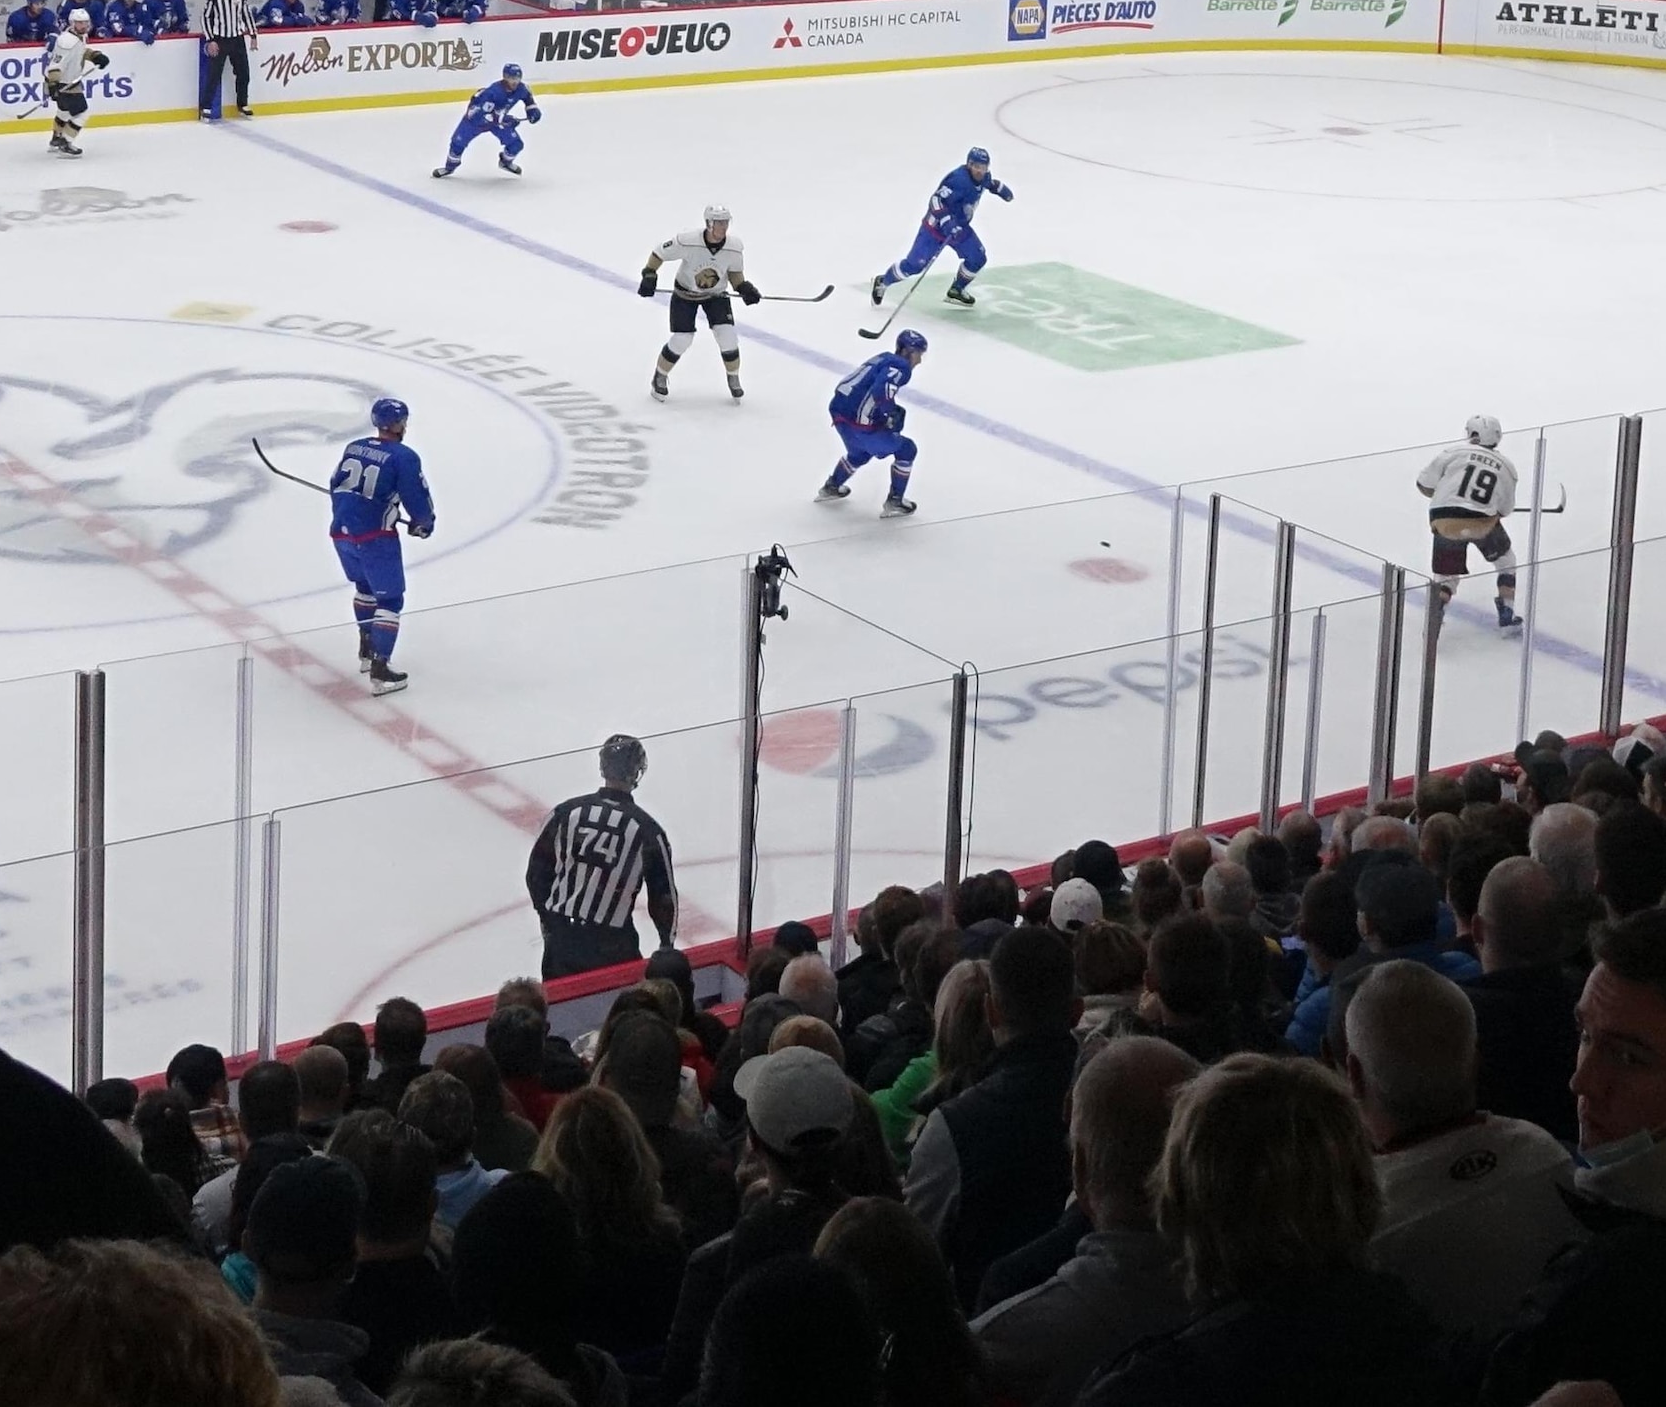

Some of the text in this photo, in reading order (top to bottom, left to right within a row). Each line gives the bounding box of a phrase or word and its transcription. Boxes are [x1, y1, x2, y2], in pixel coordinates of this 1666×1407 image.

[807, 9, 961, 33] MITSUBISHI HC CAPITAL
[1016, 5, 1039, 25] NAPA
[1052, 0, 1156, 24] PIÈCES D'AUTO
[807, 31, 864, 48] CANADA
[1498, 24, 1561, 40] PERFORMANCE
[260, 39, 483, 87] Molson EXPORT ALE
[264, 313, 656, 531] COLISÉE VIDÉOTRON
[1469, 453, 1502, 472] GREEN
[333, 458, 381, 500] 21
[1457, 464, 1498, 505] 19
[944, 634, 1309, 743] pepsi
[578, 826, 618, 865] 74
